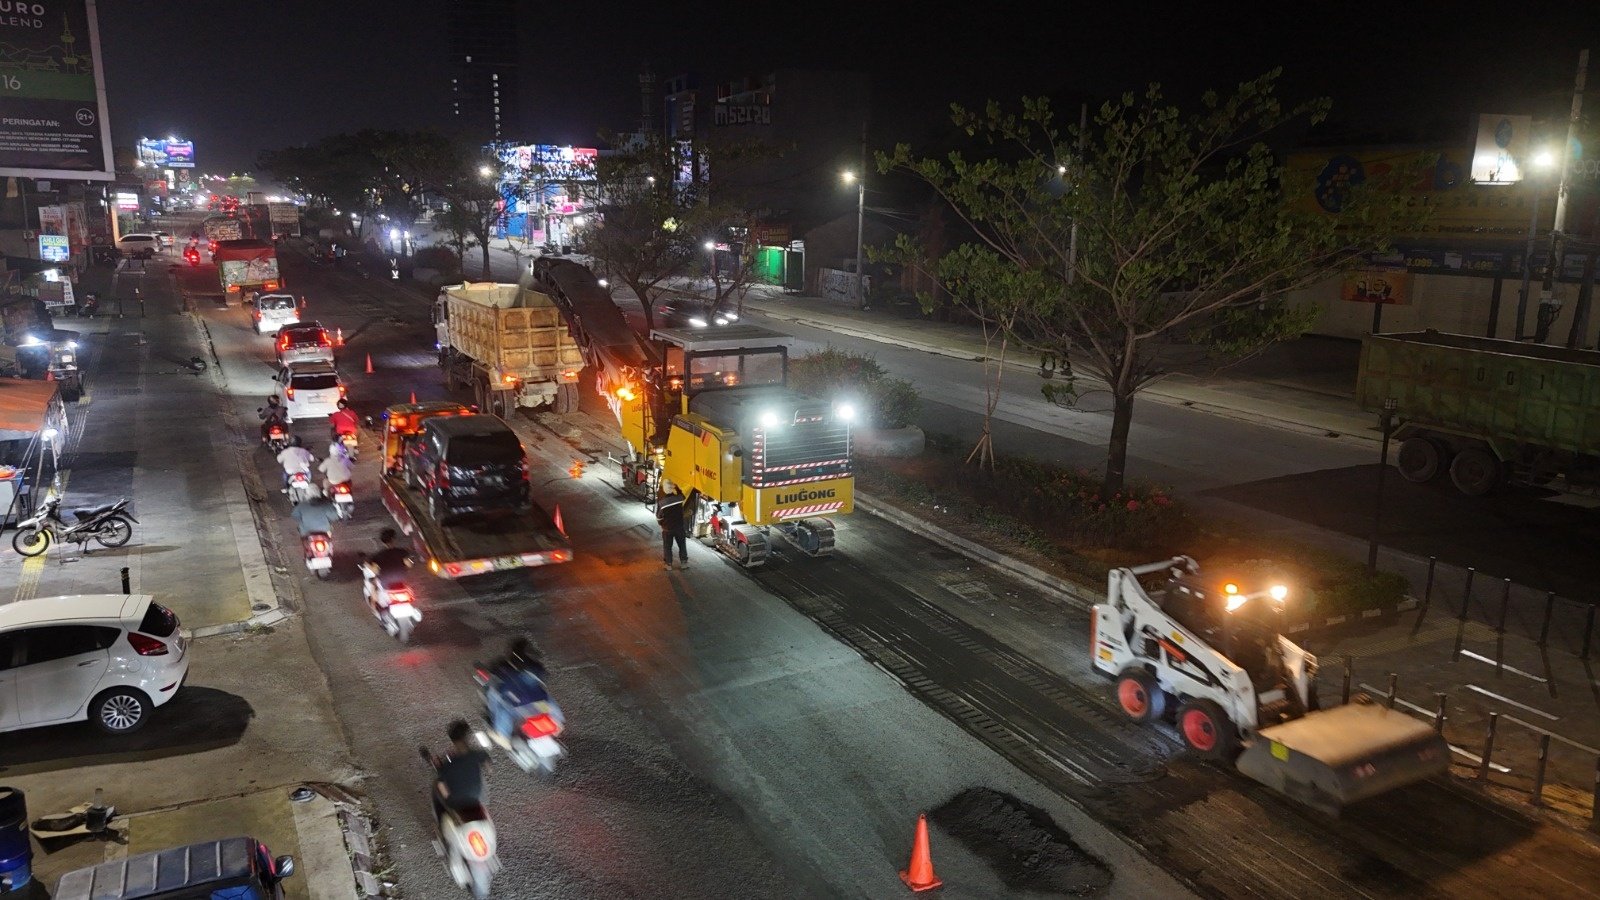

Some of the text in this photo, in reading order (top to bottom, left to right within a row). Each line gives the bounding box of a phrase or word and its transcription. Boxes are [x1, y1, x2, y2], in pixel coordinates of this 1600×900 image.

[3, 75, 21, 90] 16
[78, 113, 93, 121] 21+
[3, 118, 60, 127] PERINGATAN:
